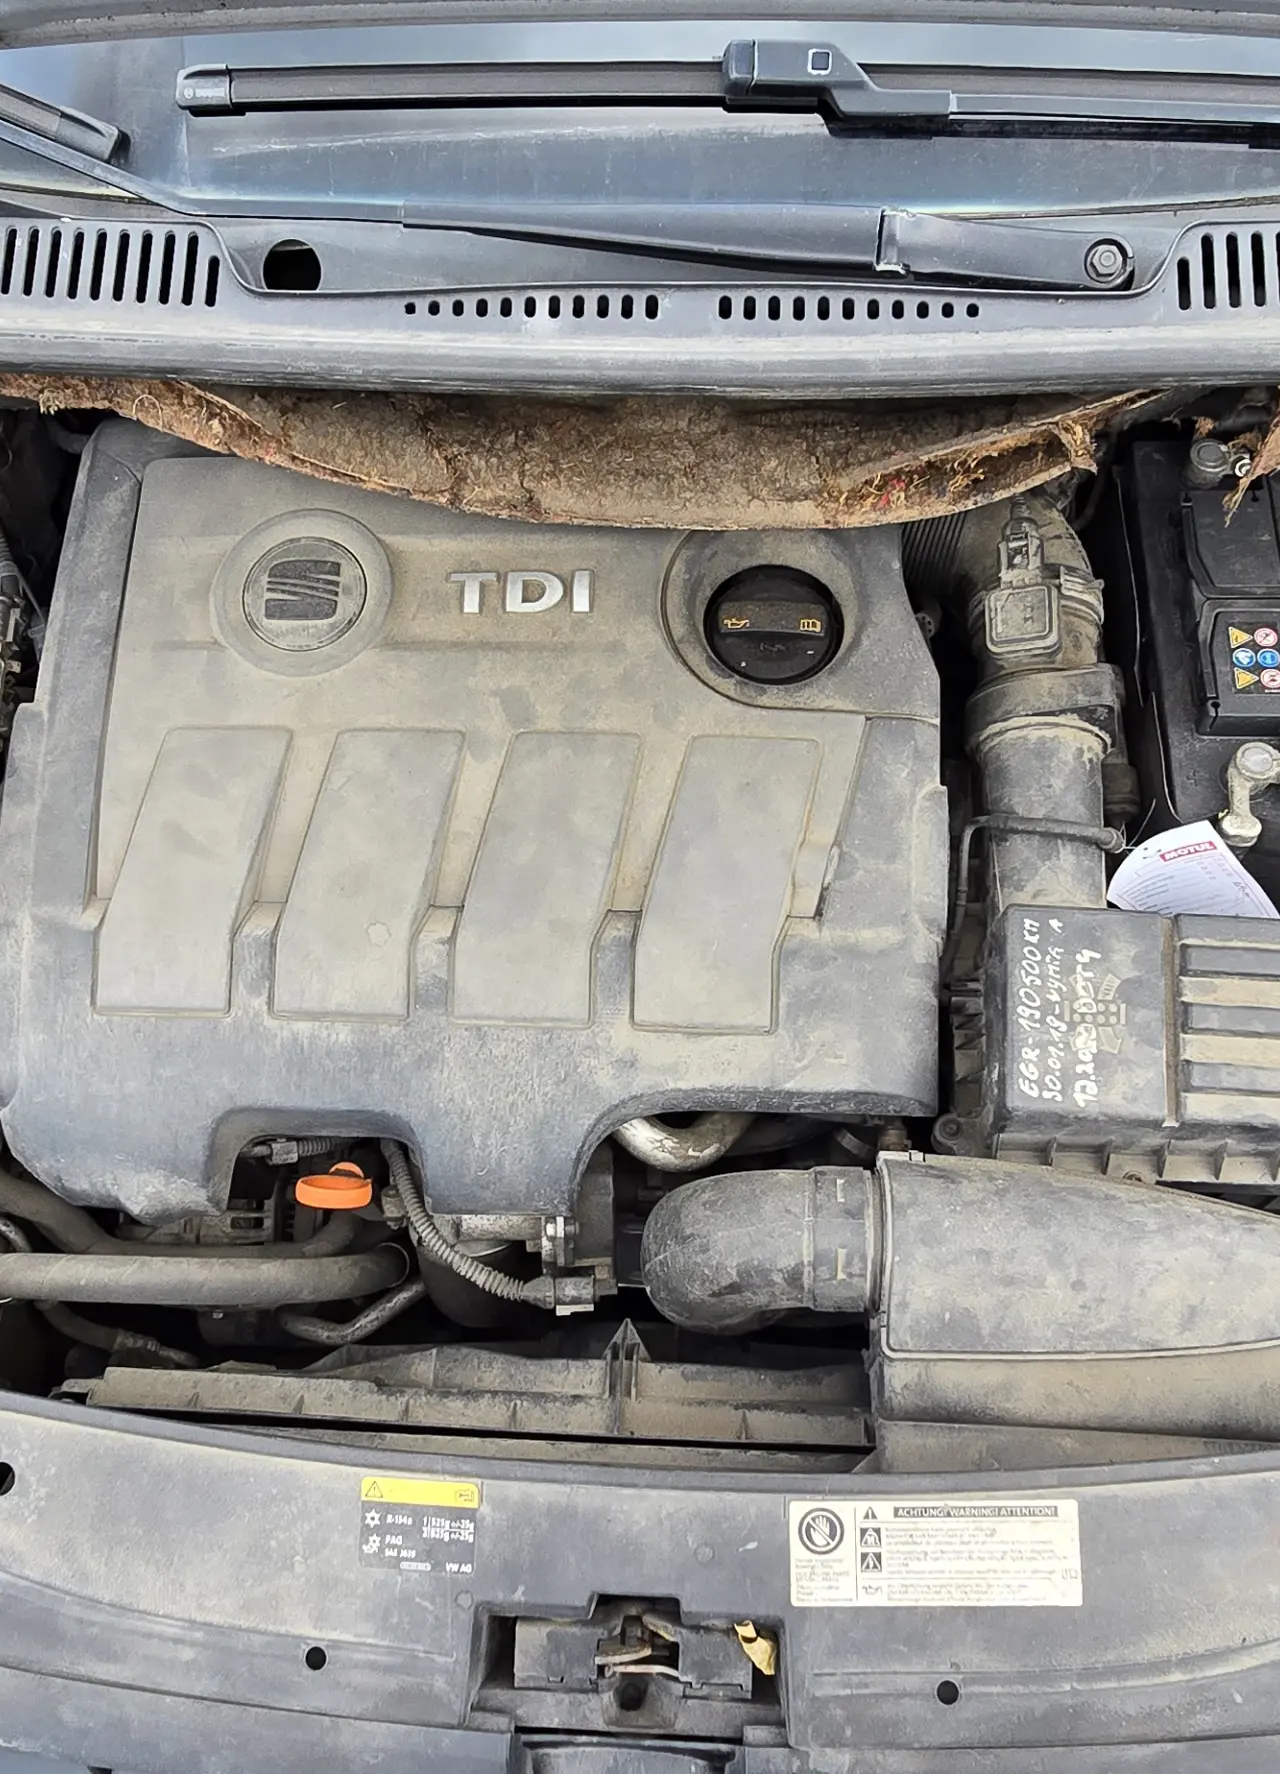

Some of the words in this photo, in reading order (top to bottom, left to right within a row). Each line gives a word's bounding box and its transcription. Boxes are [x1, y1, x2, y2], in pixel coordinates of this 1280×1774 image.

[448, 570, 594, 613] TDI
[1164, 842, 1215, 861] MOTUL
[949, 1507, 998, 1517] WARNING!
[1000, 1506, 1056, 1516] ATTENTION!
